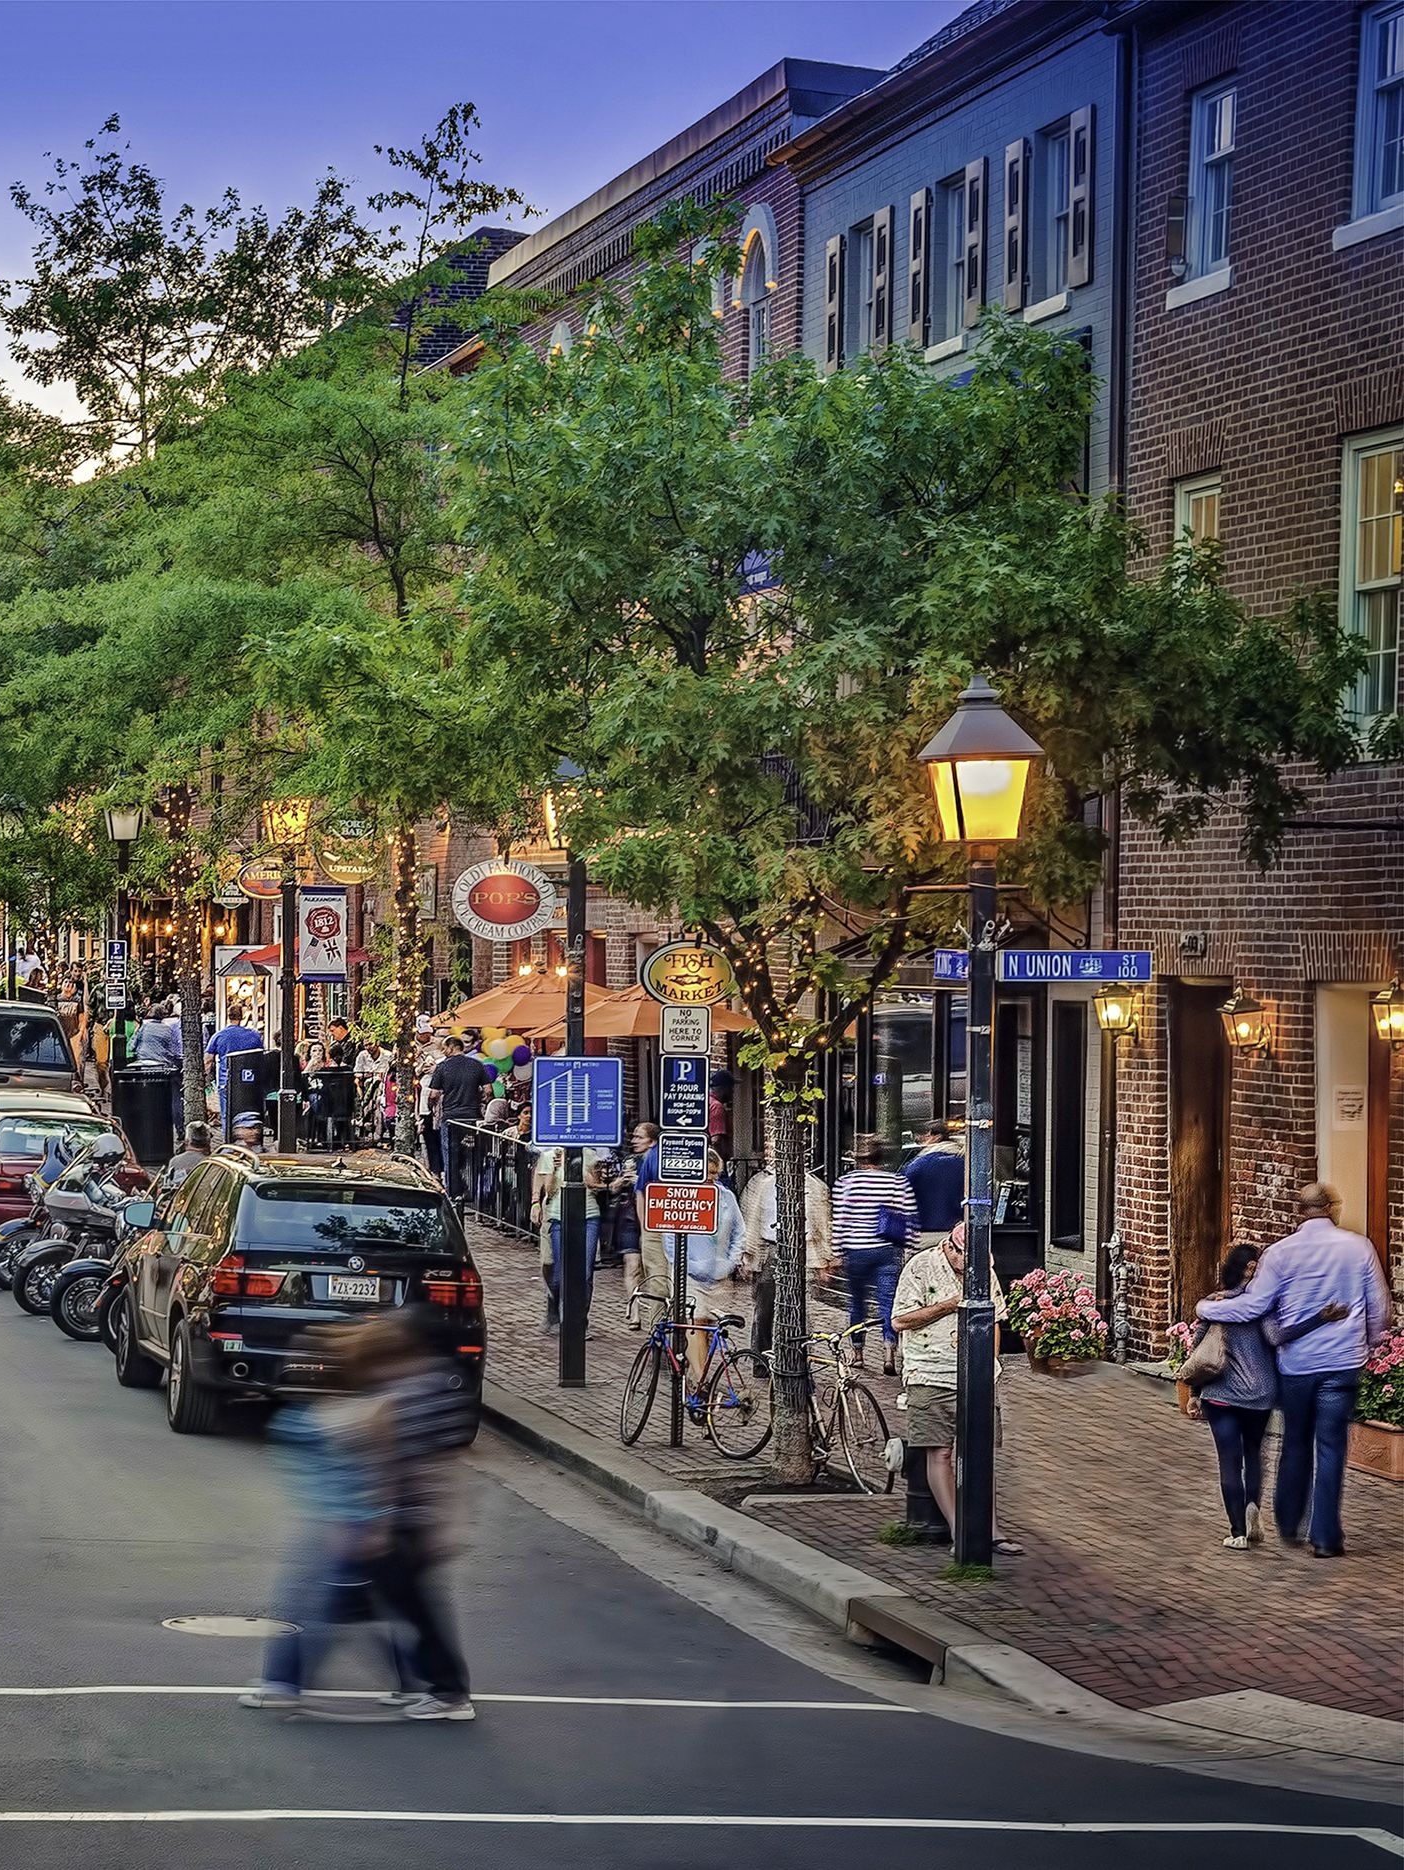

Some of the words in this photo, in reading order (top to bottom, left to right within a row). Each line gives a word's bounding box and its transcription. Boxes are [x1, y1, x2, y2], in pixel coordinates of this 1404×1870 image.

[459, 870, 480, 893] OLD
[488, 861, 550, 894] FASHIONED
[473, 891, 537, 905] POP'S
[314, 916, 334, 928] 1812
[456, 900, 470, 917] ICE
[468, 917, 504, 938] CREAM
[508, 903, 552, 938] COMPANY
[113, 943, 121, 955] P
[664, 954, 714, 973] FISH
[1009, 955, 1019, 977] N
[1026, 955, 1072, 977] UNION
[1122, 955, 1137, 966] ST
[1118, 966, 1139, 978] 100
[655, 979, 724, 1001] MARKET
[679, 1009, 692, 1017] NO
[244, 1070, 252, 1080] P
[677, 1061, 692, 1081] P
[670, 1084, 676, 1092] 2
[677, 1084, 699, 1092] HOUR
[678, 1093, 705, 1101] PARKING
[662, 1138, 684, 1146] Payment
[685, 1139, 704, 1147] Options
[667, 1160, 701, 1168] 22502
[667, 1187, 699, 1199] SNOW
[649, 1198, 714, 1211] EMERGENCY
[663, 1211, 699, 1222] ROUTE
